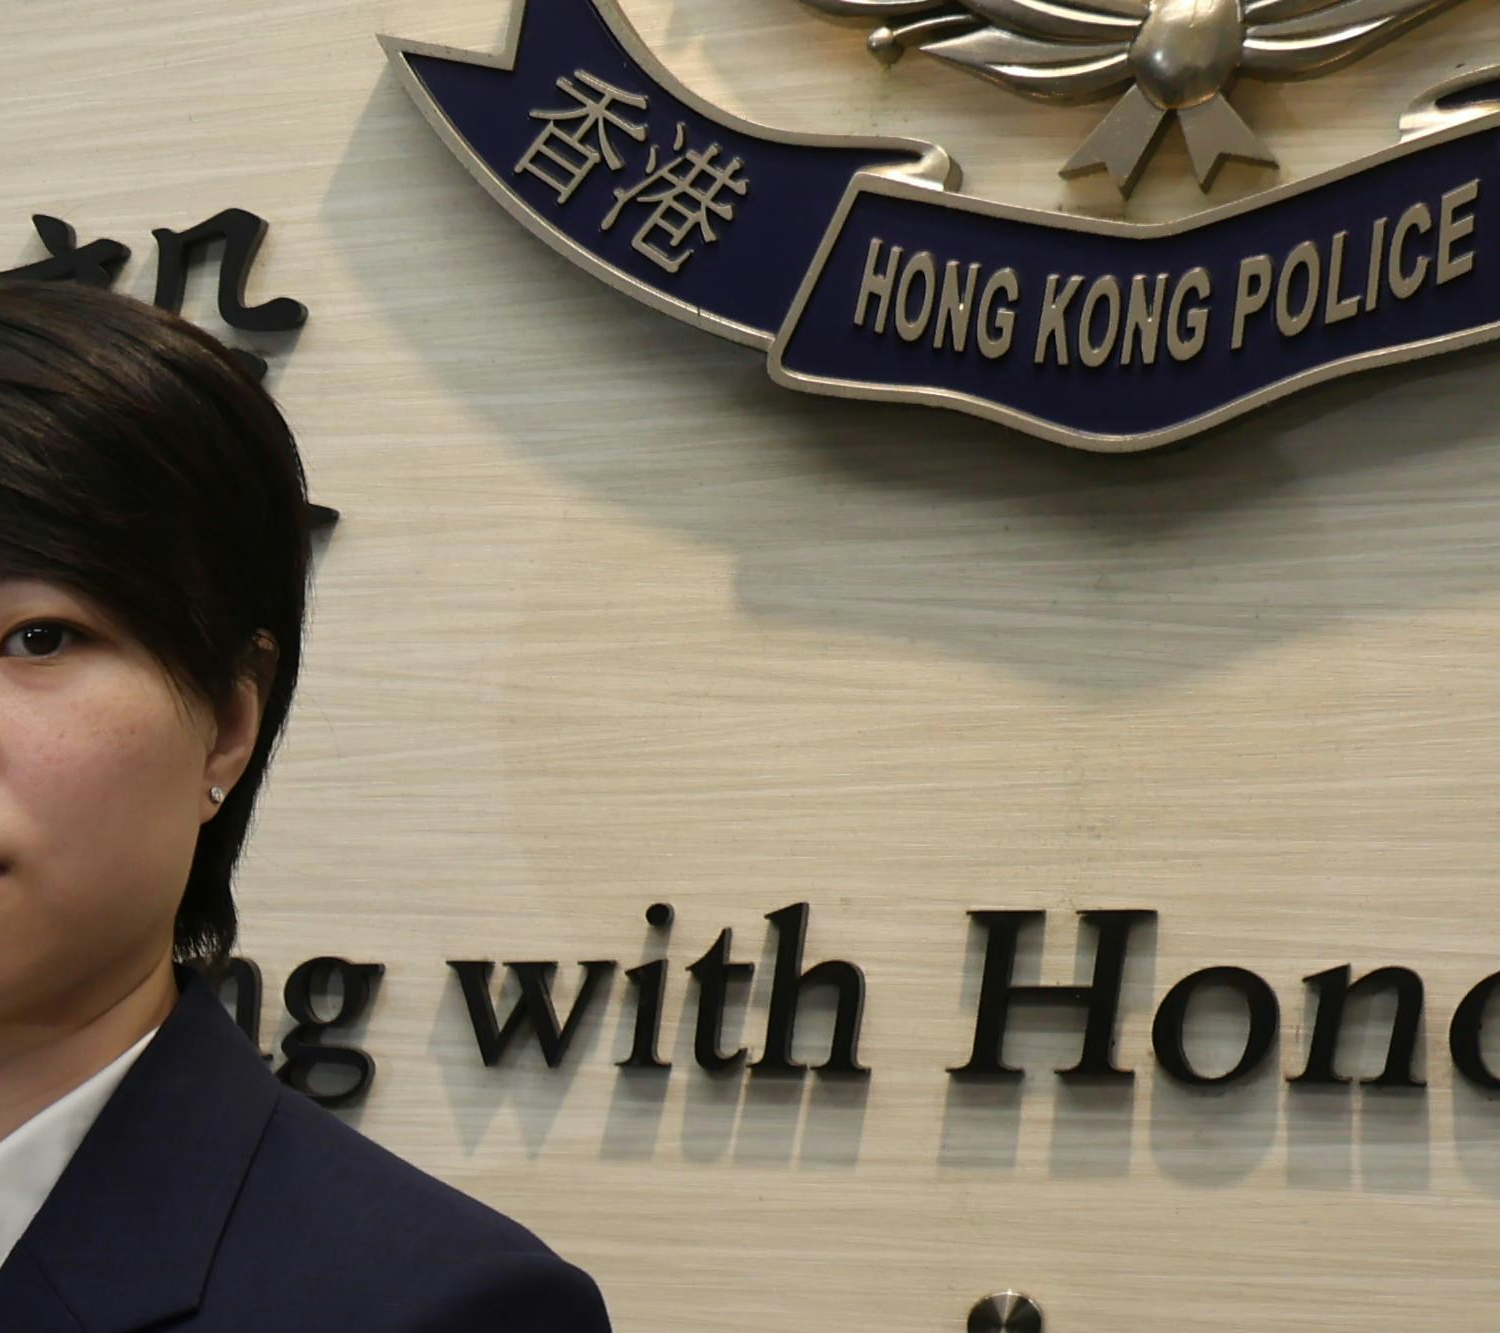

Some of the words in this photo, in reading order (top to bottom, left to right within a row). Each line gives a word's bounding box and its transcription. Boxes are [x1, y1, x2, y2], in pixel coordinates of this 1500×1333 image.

[513, 69, 749, 273] 香港
[853, 237, 1020, 359] HONG
[1034, 266, 1212, 367] KONG
[1231, 178, 1481, 350] POLICE
[446, 901, 872, 1077] with
